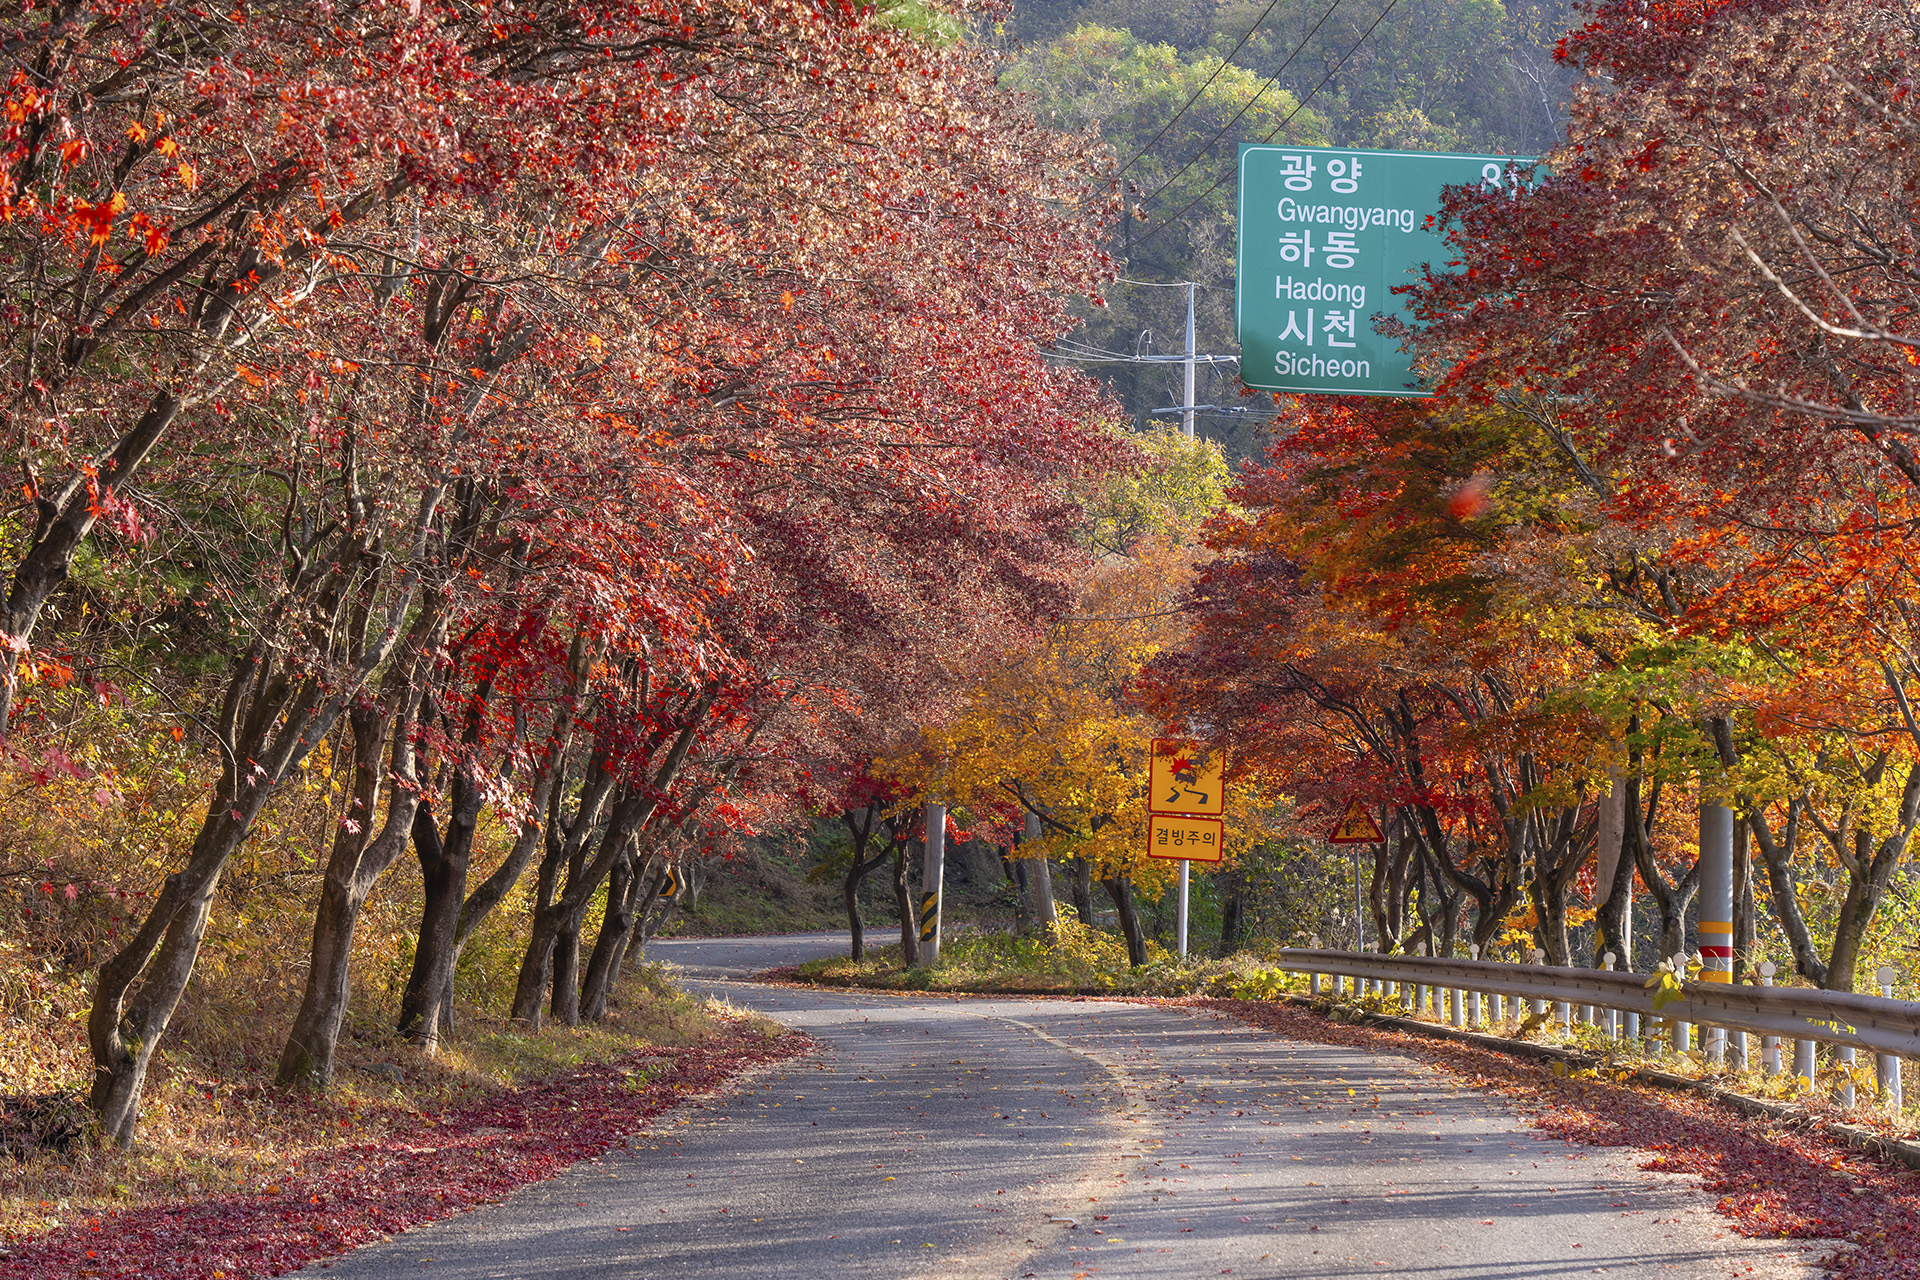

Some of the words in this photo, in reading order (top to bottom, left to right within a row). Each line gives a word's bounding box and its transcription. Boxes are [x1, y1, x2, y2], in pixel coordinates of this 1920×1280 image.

[1279, 155, 1363, 194] 광양
[1277, 197, 1415, 233] Gwangyang
[1278, 229, 1360, 269] 하동
[1275, 275, 1366, 309] Hadong
[1277, 308, 1357, 348] 시천
[1274, 350, 1371, 379] Sicheon
[1156, 828, 1215, 847] 결빙주의
